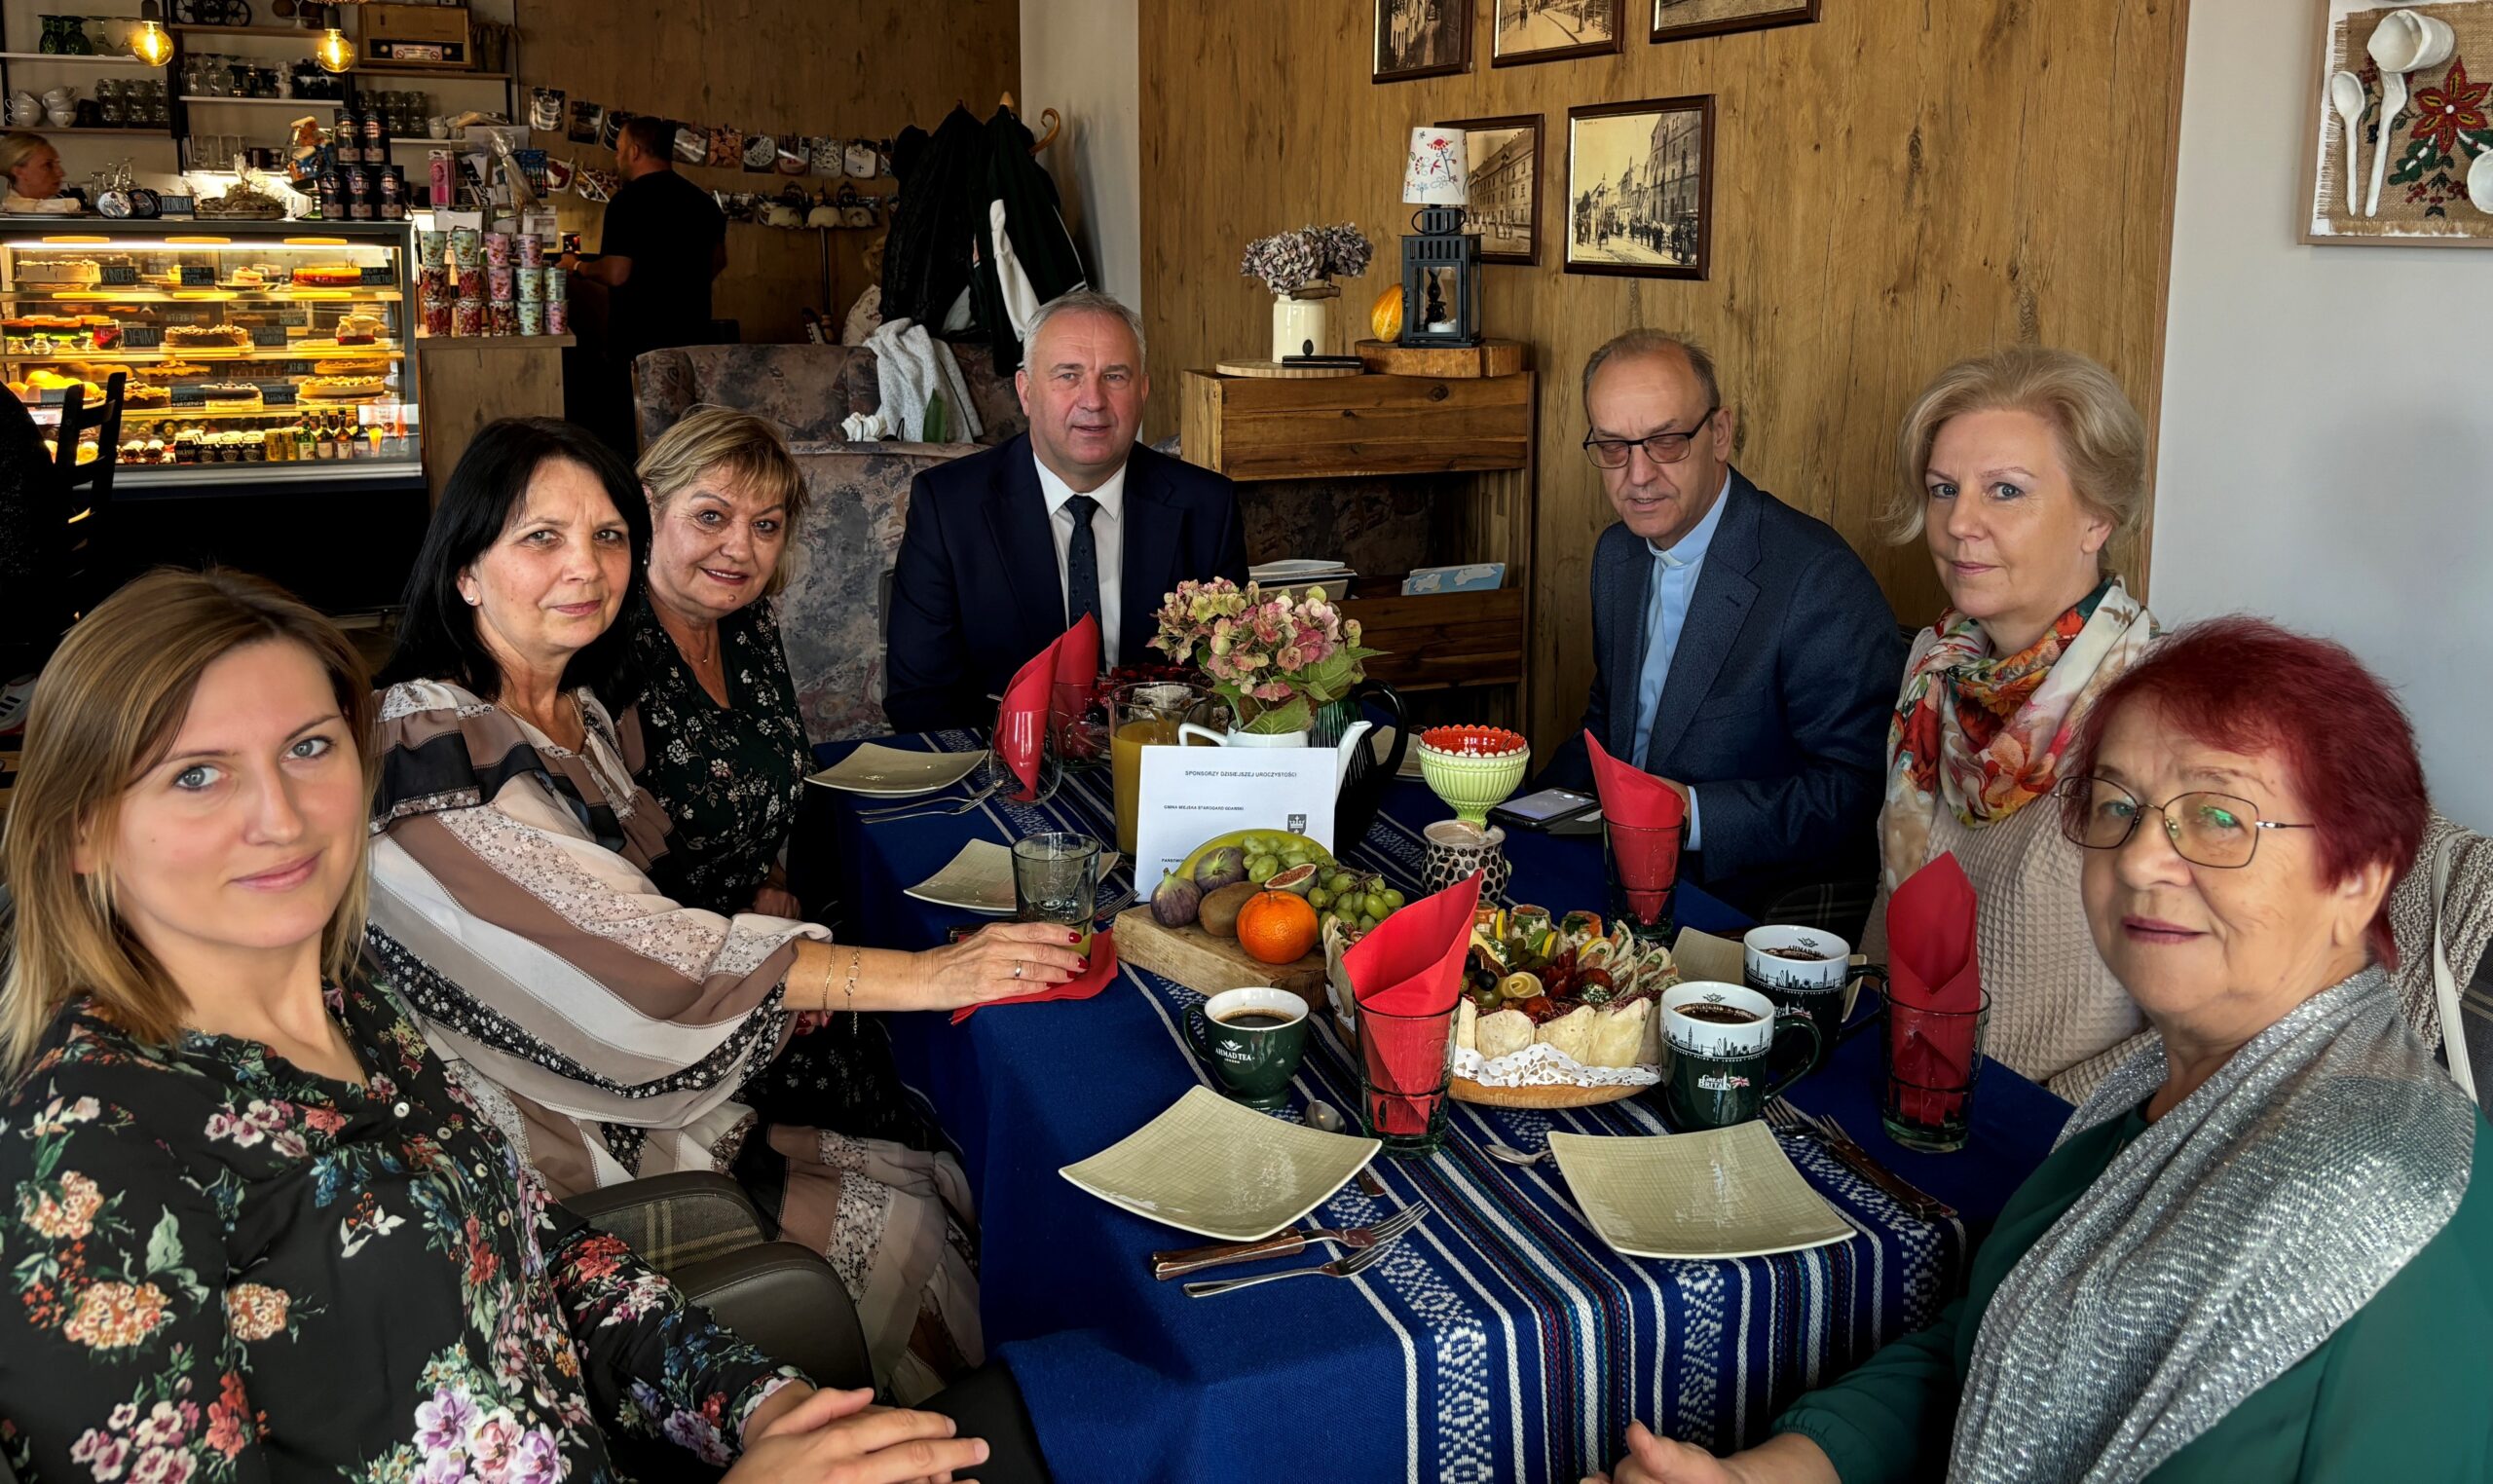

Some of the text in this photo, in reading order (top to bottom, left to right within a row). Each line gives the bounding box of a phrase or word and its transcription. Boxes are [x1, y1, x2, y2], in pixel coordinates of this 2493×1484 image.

[102, 266, 134, 282] KINDER
[125, 327, 155, 346] DAIM
[1215, 1048, 1252, 1061] AHMAD TEA
[1697, 1076, 1731, 1091] BRITAIN
[1702, 1074, 1724, 1083] GREAT
